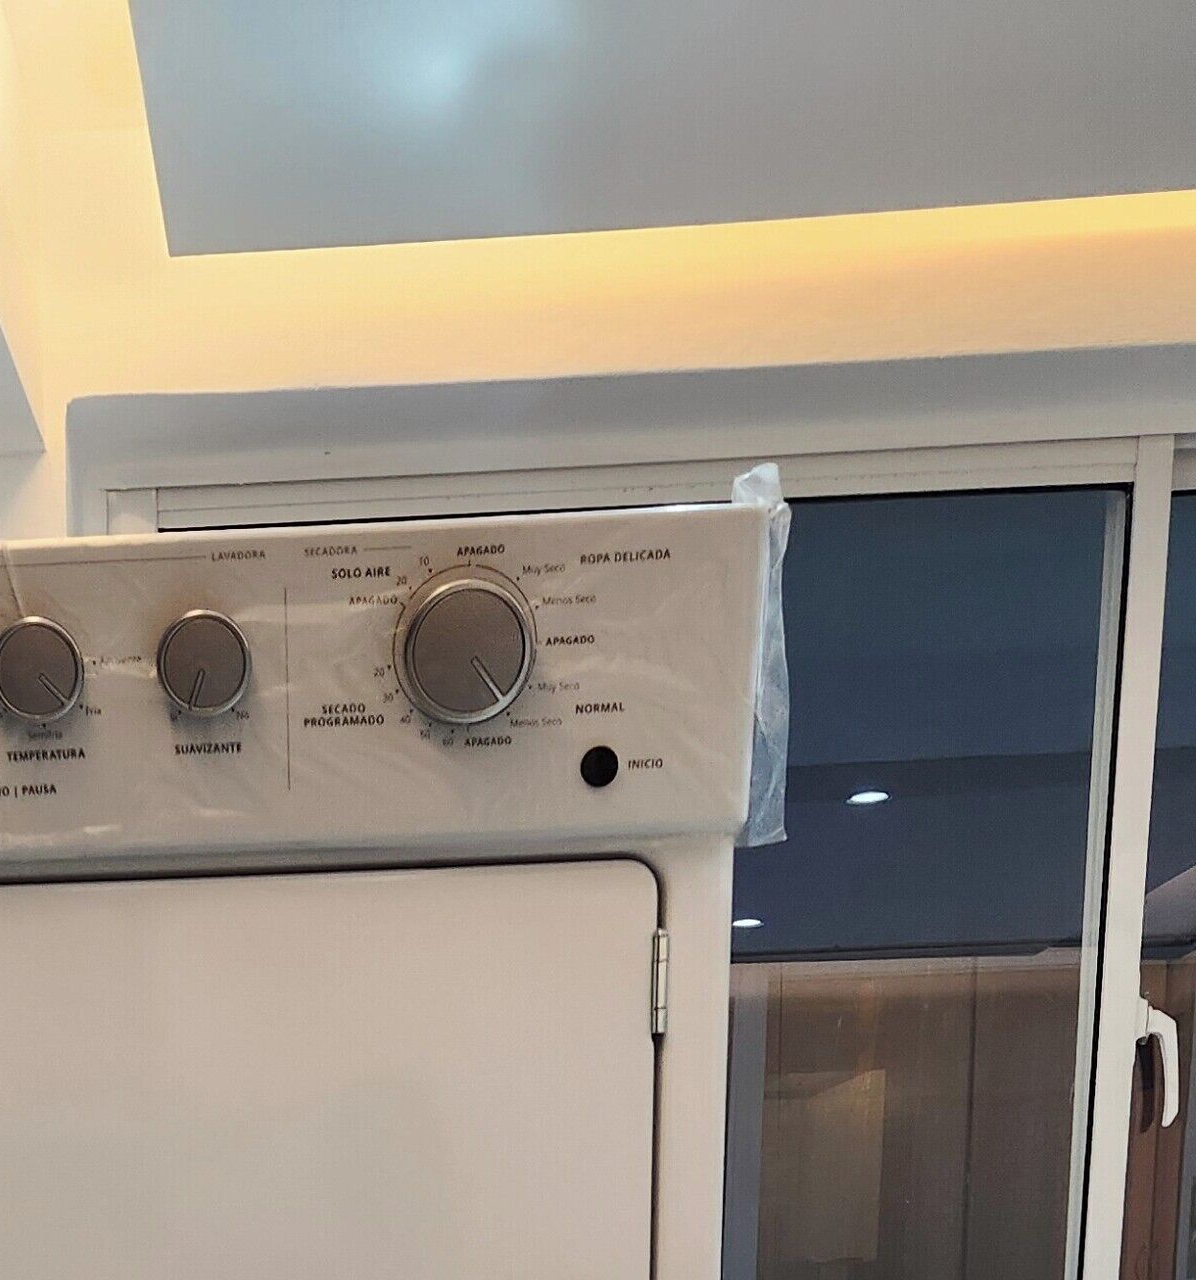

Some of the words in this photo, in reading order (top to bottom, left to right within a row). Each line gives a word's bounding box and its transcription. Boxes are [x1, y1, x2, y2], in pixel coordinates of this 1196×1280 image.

[304, 546, 358, 557] SECADORA
[456, 543, 505, 556] APAGADO
[211, 550, 266, 562] LAVADORA
[419, 555, 430, 566] 10
[580, 552, 611, 565] ROPA
[614, 548, 671, 563] DELICADA
[331, 567, 362, 579] SOLO
[365, 566, 392, 578] AIRE
[349, 596, 398, 606] APAGADO
[545, 635, 595, 646] APAGADO
[321, 703, 366, 715] SECADO
[575, 702, 625, 714] NORMAL
[304, 715, 384, 727] PROGRAMADO
[464, 736, 512, 747] APAGADO
[7, 747, 86, 762] TEMPERATURA
[175, 742, 242, 755] SUAVIZANTE
[628, 758, 663, 769] INICIO
[22, 784, 57, 796] PAUSA
